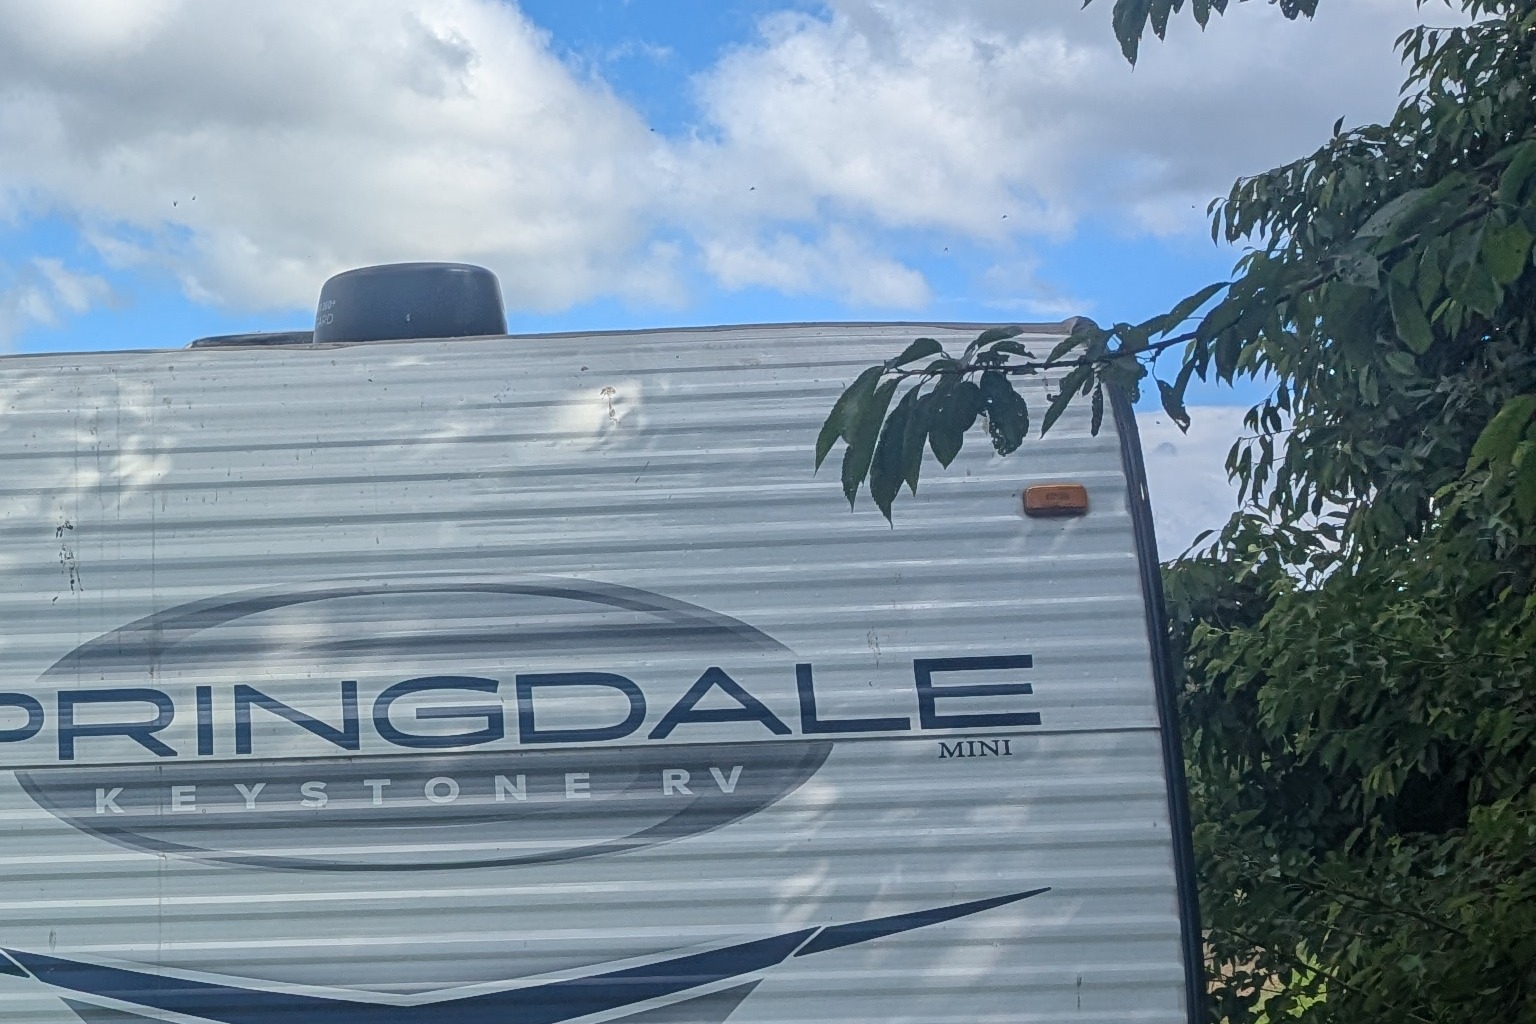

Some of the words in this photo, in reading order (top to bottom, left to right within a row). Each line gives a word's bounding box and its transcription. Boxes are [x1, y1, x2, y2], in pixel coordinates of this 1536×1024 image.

[938, 740, 1013, 759] MINI
[95, 772, 591, 814] KEYSTONE
[663, 766, 744, 796] RV
